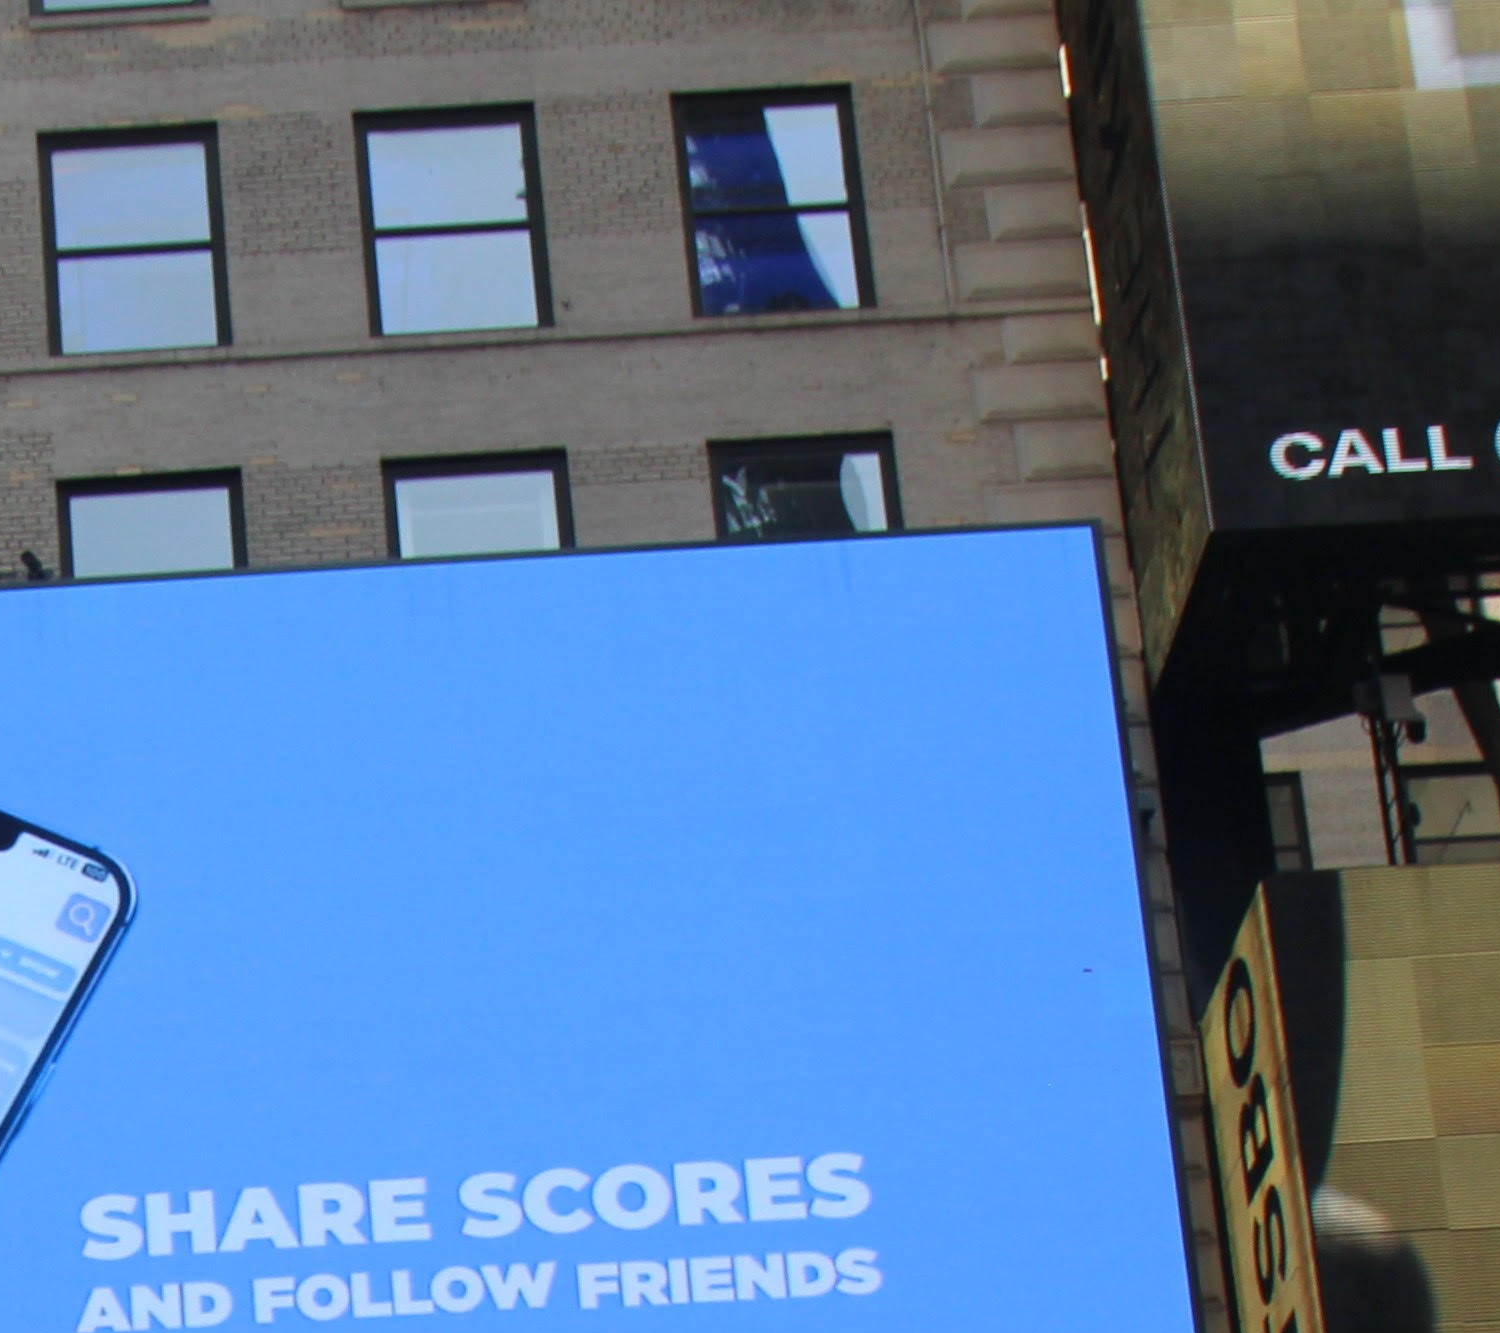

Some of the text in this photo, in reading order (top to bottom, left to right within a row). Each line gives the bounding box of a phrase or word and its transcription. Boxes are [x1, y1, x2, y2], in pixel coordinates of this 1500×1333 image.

[1269, 424, 1473, 482] CALL
[57, 854, 79, 872] LTE
[80, 1153, 871, 1261] SHARE SCORES
[253, 1262, 557, 1325] FOLLOW
[576, 1247, 883, 1310] FRIENDS
